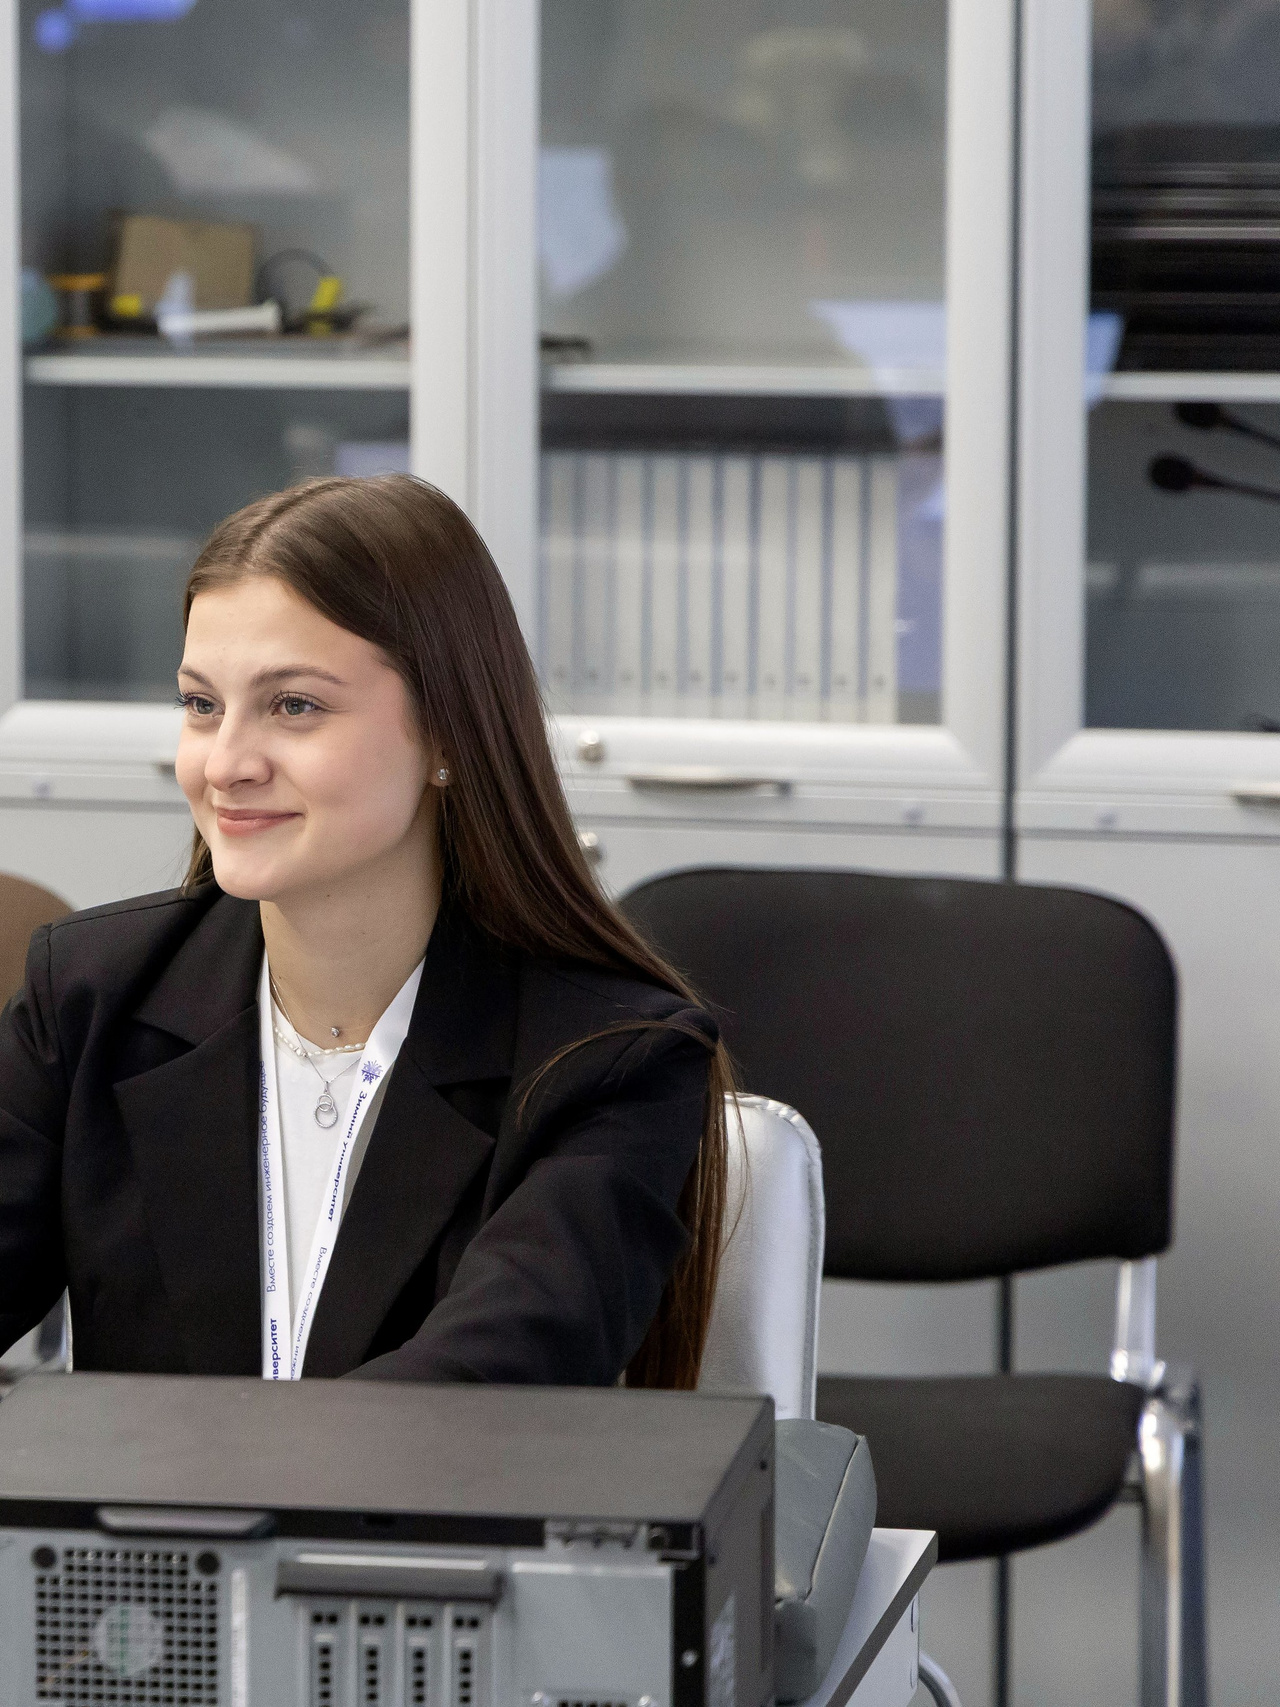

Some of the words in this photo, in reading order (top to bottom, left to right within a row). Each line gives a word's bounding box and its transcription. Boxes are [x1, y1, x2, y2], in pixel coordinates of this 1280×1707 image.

[259, 1060, 270, 1113] будущее
[347, 1090, 368, 1139] Зимний
[261, 1115, 272, 1191] инженерное
[327, 1141, 349, 1222] университет
[266, 1194, 275, 1246] создаем
[266, 1249, 276, 1293] Вместе
[310, 1246, 328, 1289] Вместе
[297, 1291, 313, 1342] создаем
